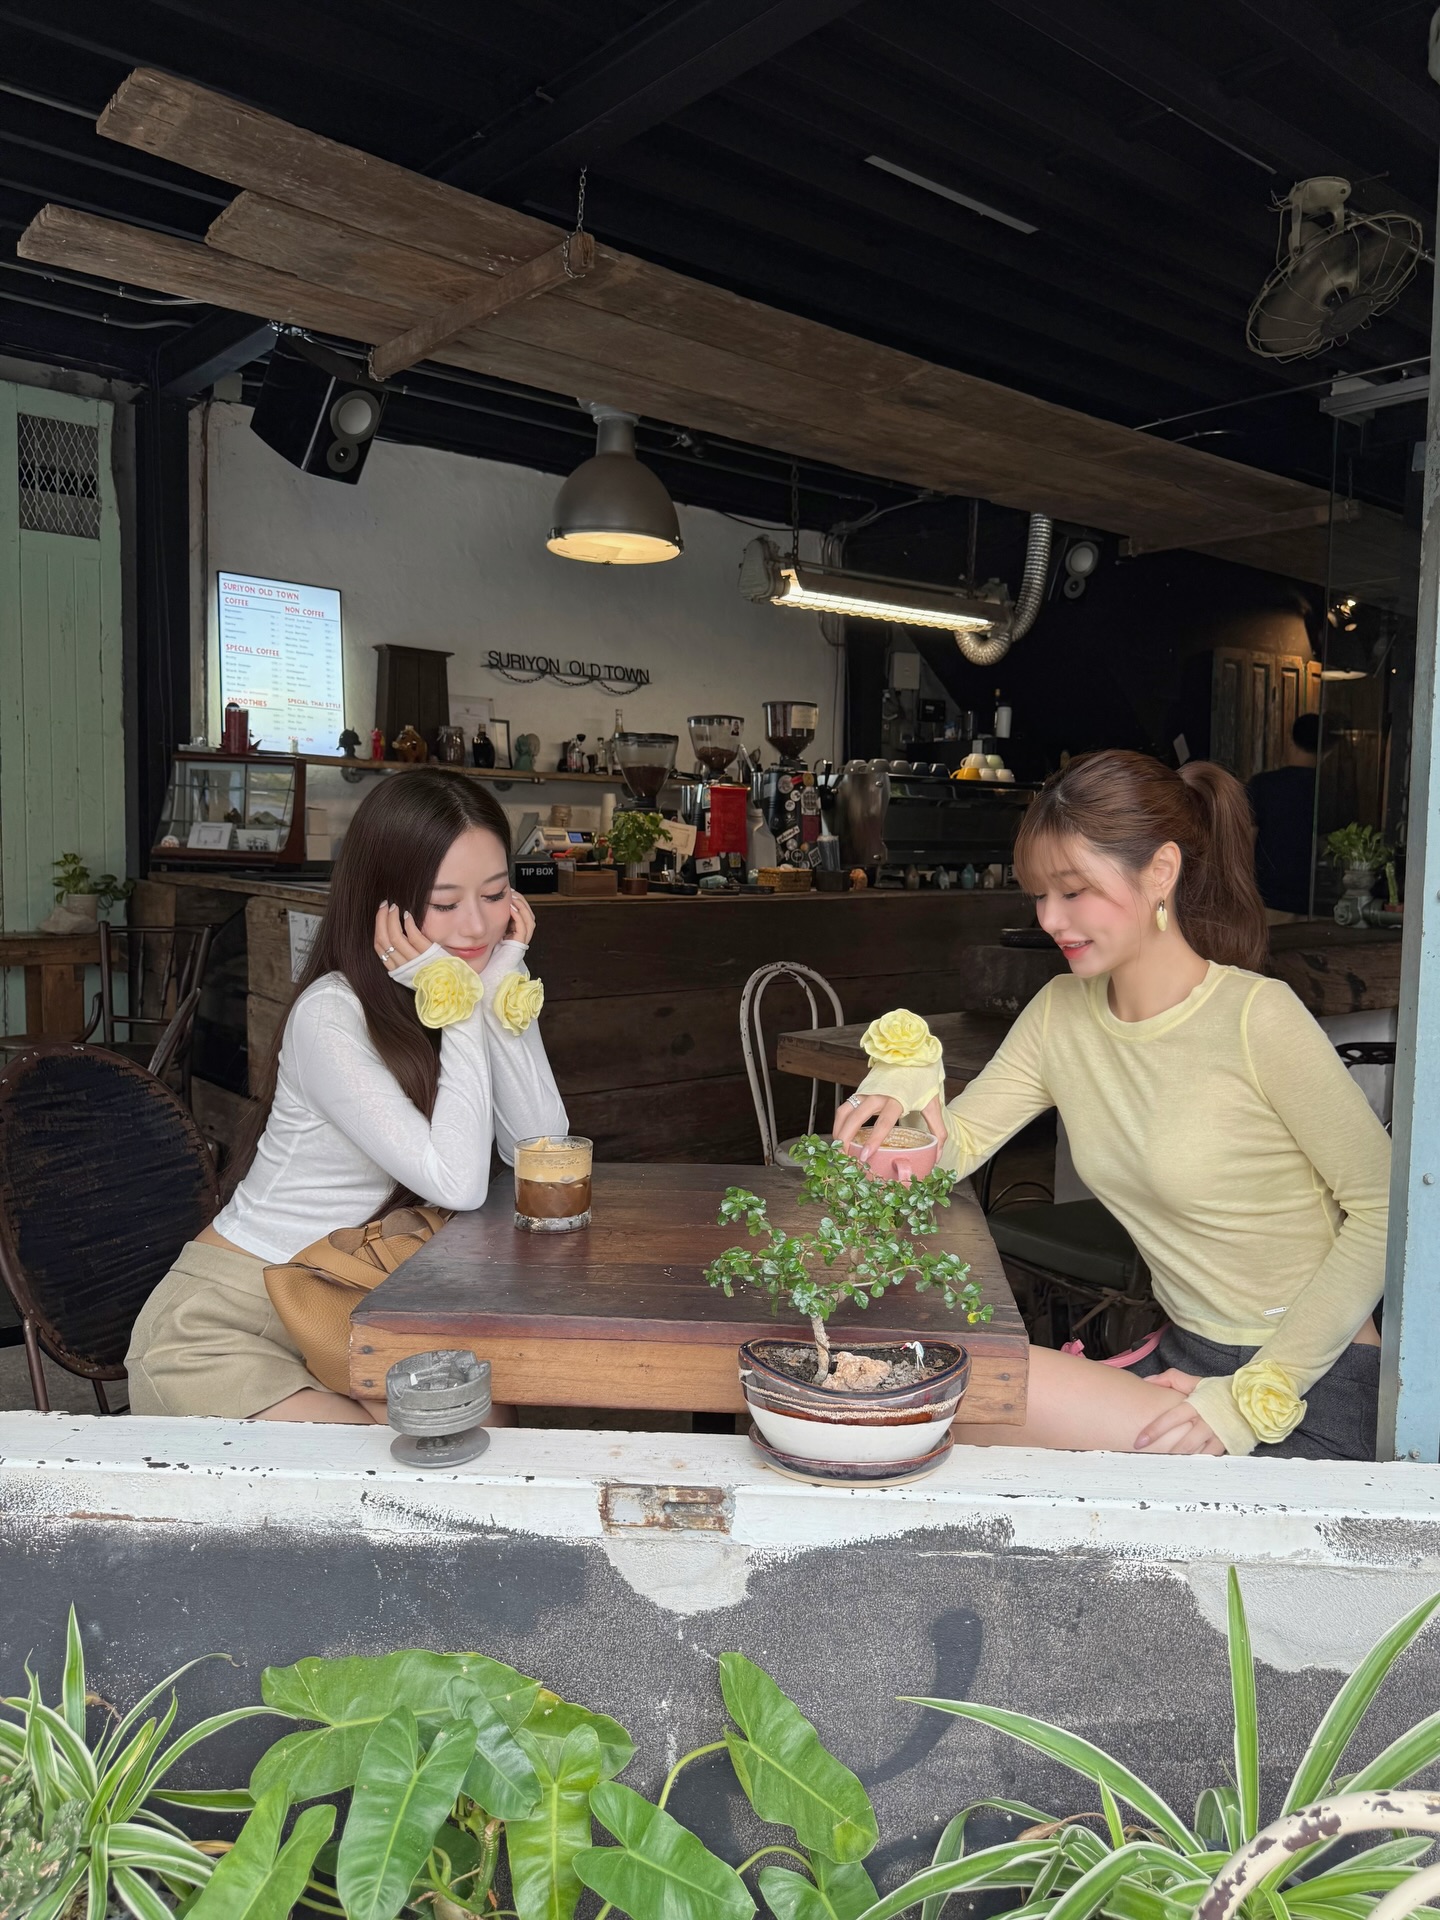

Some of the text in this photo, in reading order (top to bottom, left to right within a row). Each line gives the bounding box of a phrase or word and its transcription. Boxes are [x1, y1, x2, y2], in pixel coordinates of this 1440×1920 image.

[223, 582, 299, 601] SURIYON OLD TOWN
[225, 596, 249, 607] COFFEE
[285, 606, 325, 618] NON COFFEE
[226, 643, 279, 657] SPECIAL COFFEE
[488, 650, 650, 683] SURIYON OLD TOWN
[227, 696, 267, 707] SMOOTHIES
[287, 698, 309, 706] SPECIAL
[521, 867, 554, 876] TIP BOX
